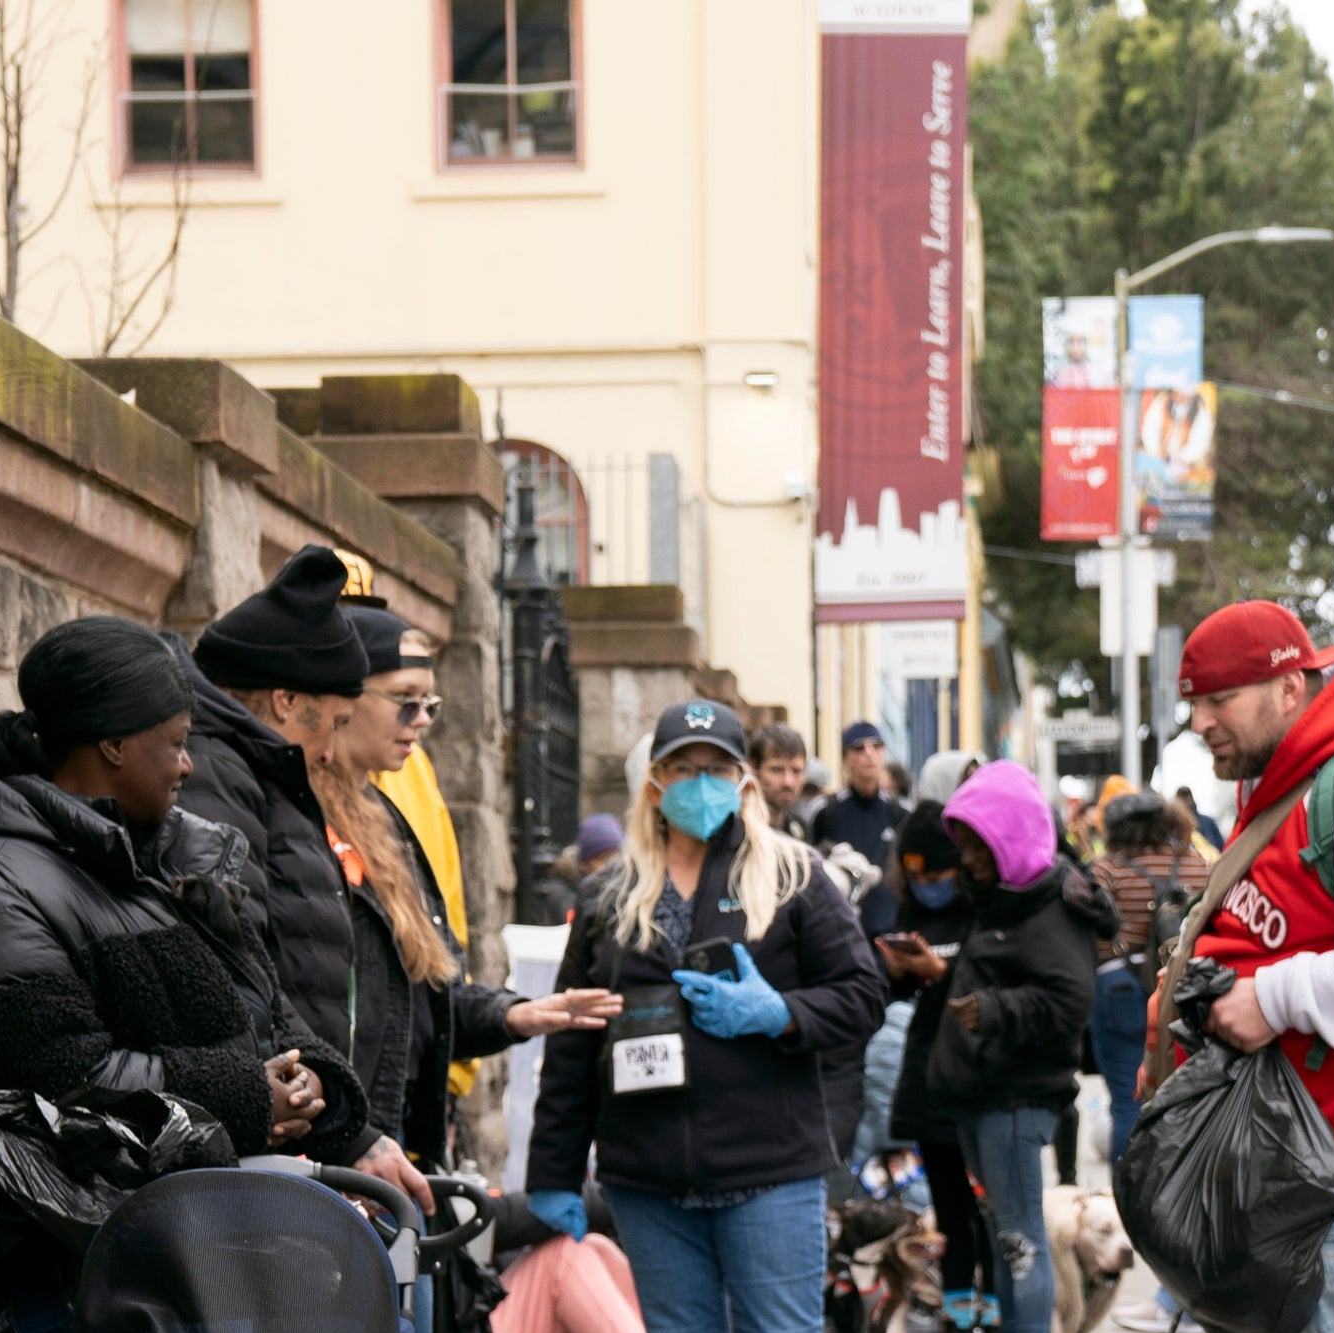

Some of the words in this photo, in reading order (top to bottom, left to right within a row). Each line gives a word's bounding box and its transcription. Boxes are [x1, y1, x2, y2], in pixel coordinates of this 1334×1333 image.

[922, 59, 953, 137] Serve
[928, 139, 952, 171] to
[921, 172, 952, 254] Leave
[920, 259, 952, 349] Learn,
[928, 350, 950, 382] to
[920, 383, 950, 463] Enter
